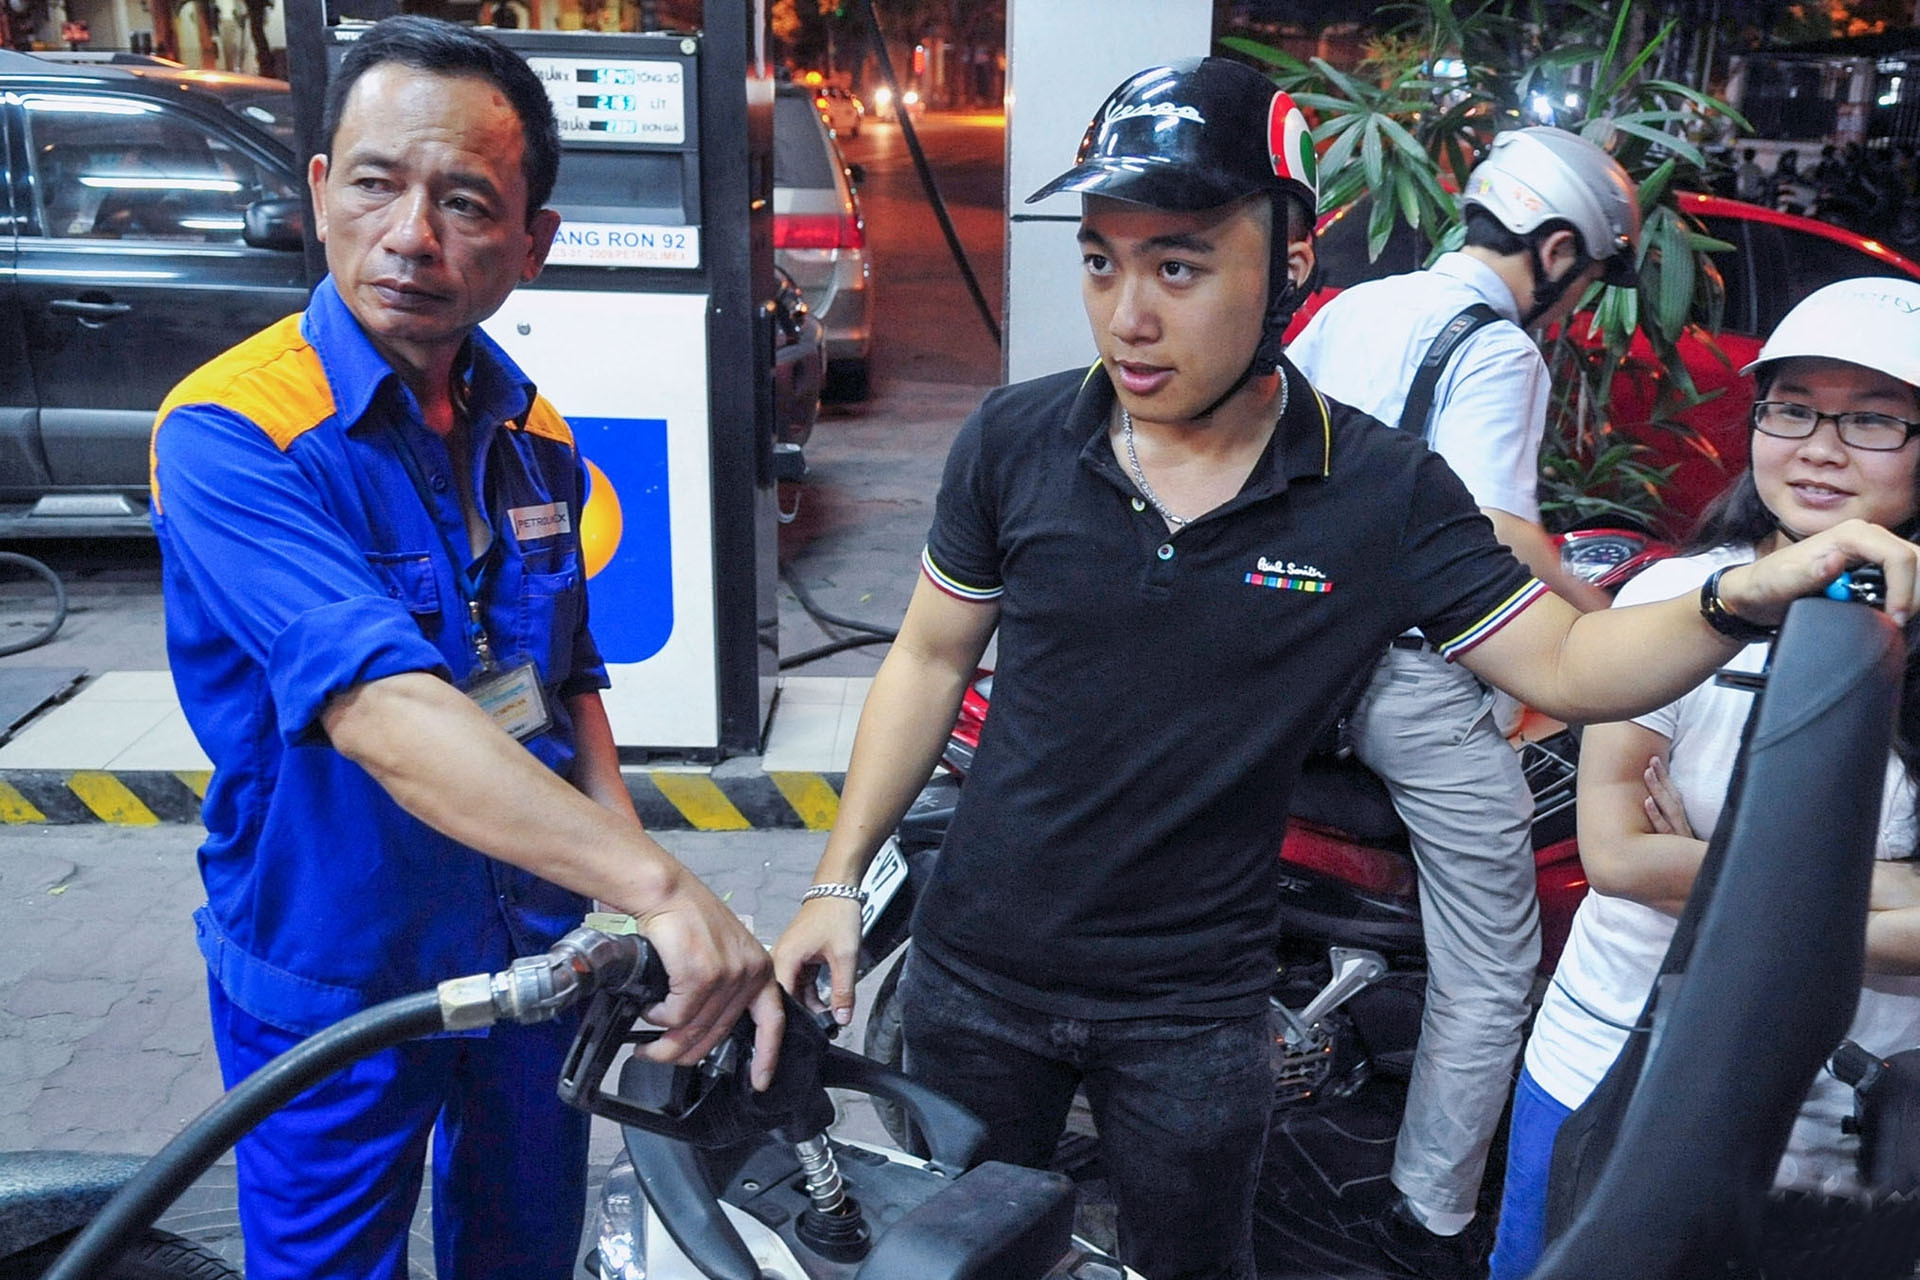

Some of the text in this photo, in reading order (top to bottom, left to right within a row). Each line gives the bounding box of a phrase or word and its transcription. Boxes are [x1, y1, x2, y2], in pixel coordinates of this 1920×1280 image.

[650, 97, 667, 110] LÍT
[1103, 98, 1206, 124] Vespa
[552, 230, 686, 249] ANG RON 92
[1257, 556, 1326, 579] Paul Smith
